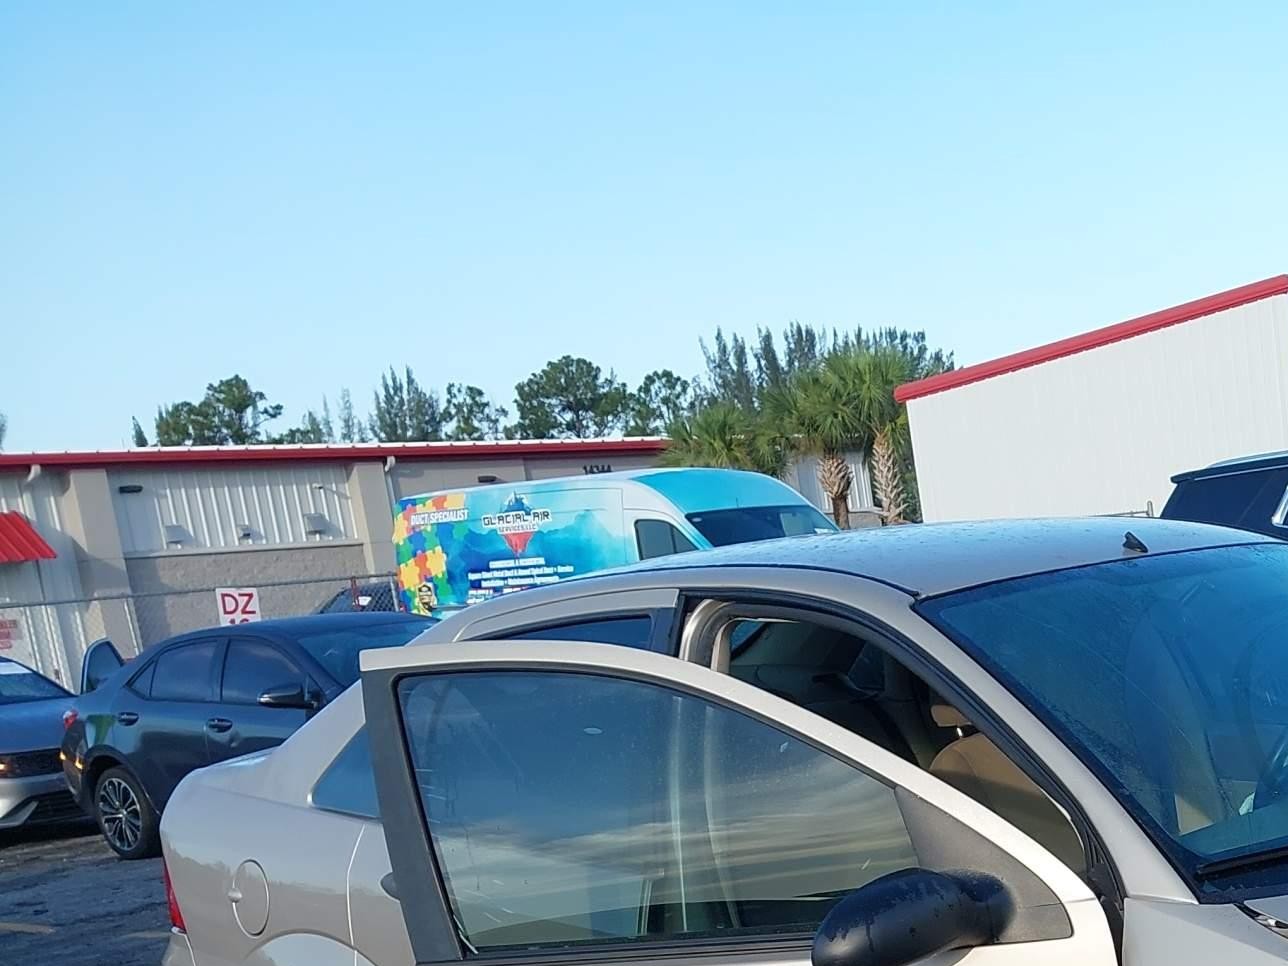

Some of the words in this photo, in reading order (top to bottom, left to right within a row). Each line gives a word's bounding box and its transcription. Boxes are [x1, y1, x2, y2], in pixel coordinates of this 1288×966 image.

[411, 514, 428, 526] DUCT
[430, 509, 469, 524] SPECIALIST
[483, 513, 528, 526] GLACIAL
[533, 511, 550, 522] AIR
[220, 592, 257, 615] DZ
